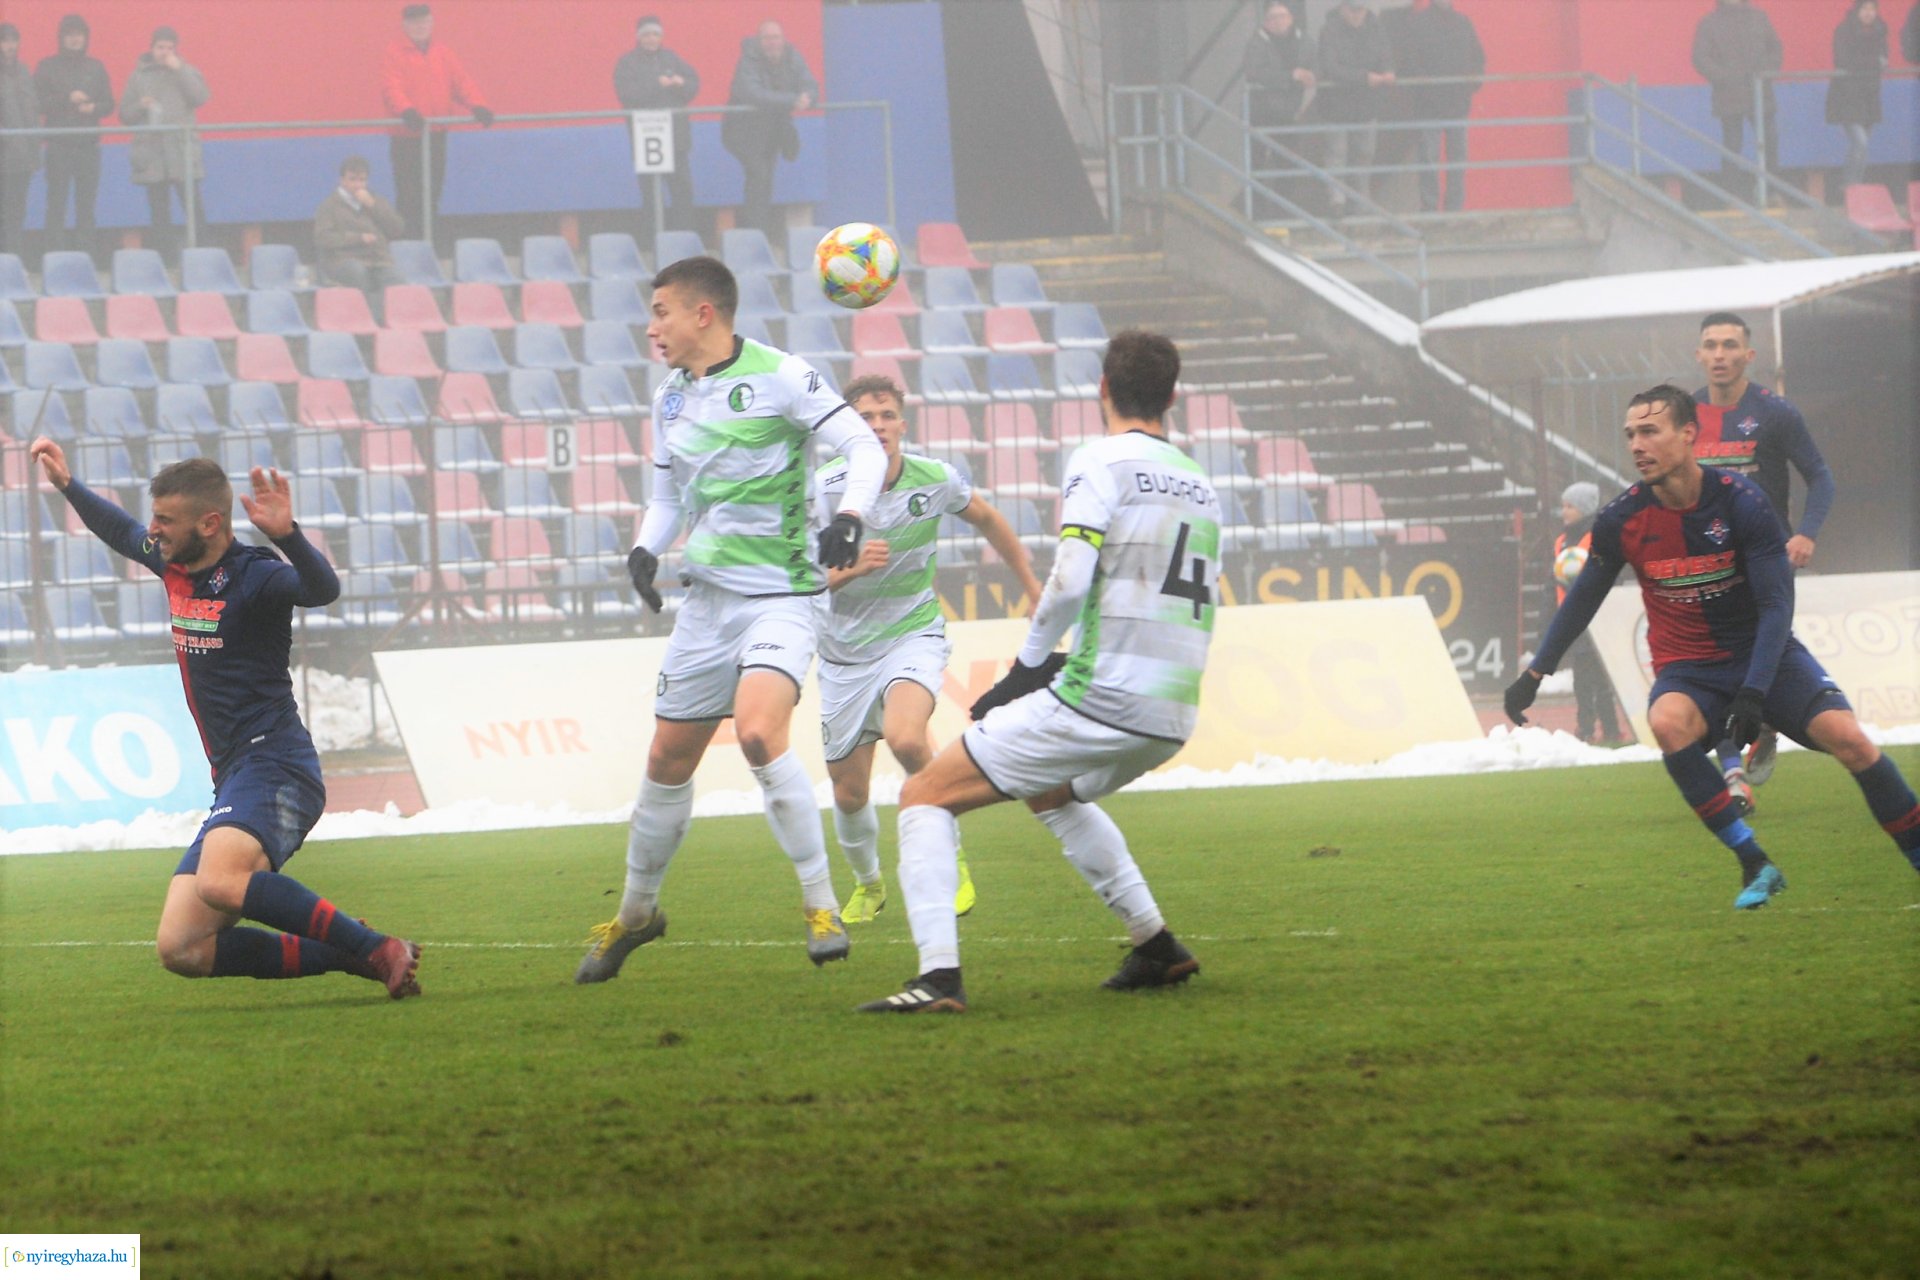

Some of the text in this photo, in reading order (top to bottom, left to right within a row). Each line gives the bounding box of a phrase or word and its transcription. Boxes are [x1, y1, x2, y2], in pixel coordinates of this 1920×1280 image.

[644, 136, 664, 167] B
[553, 428, 571, 467] B
[1160, 521, 1212, 621] 4
